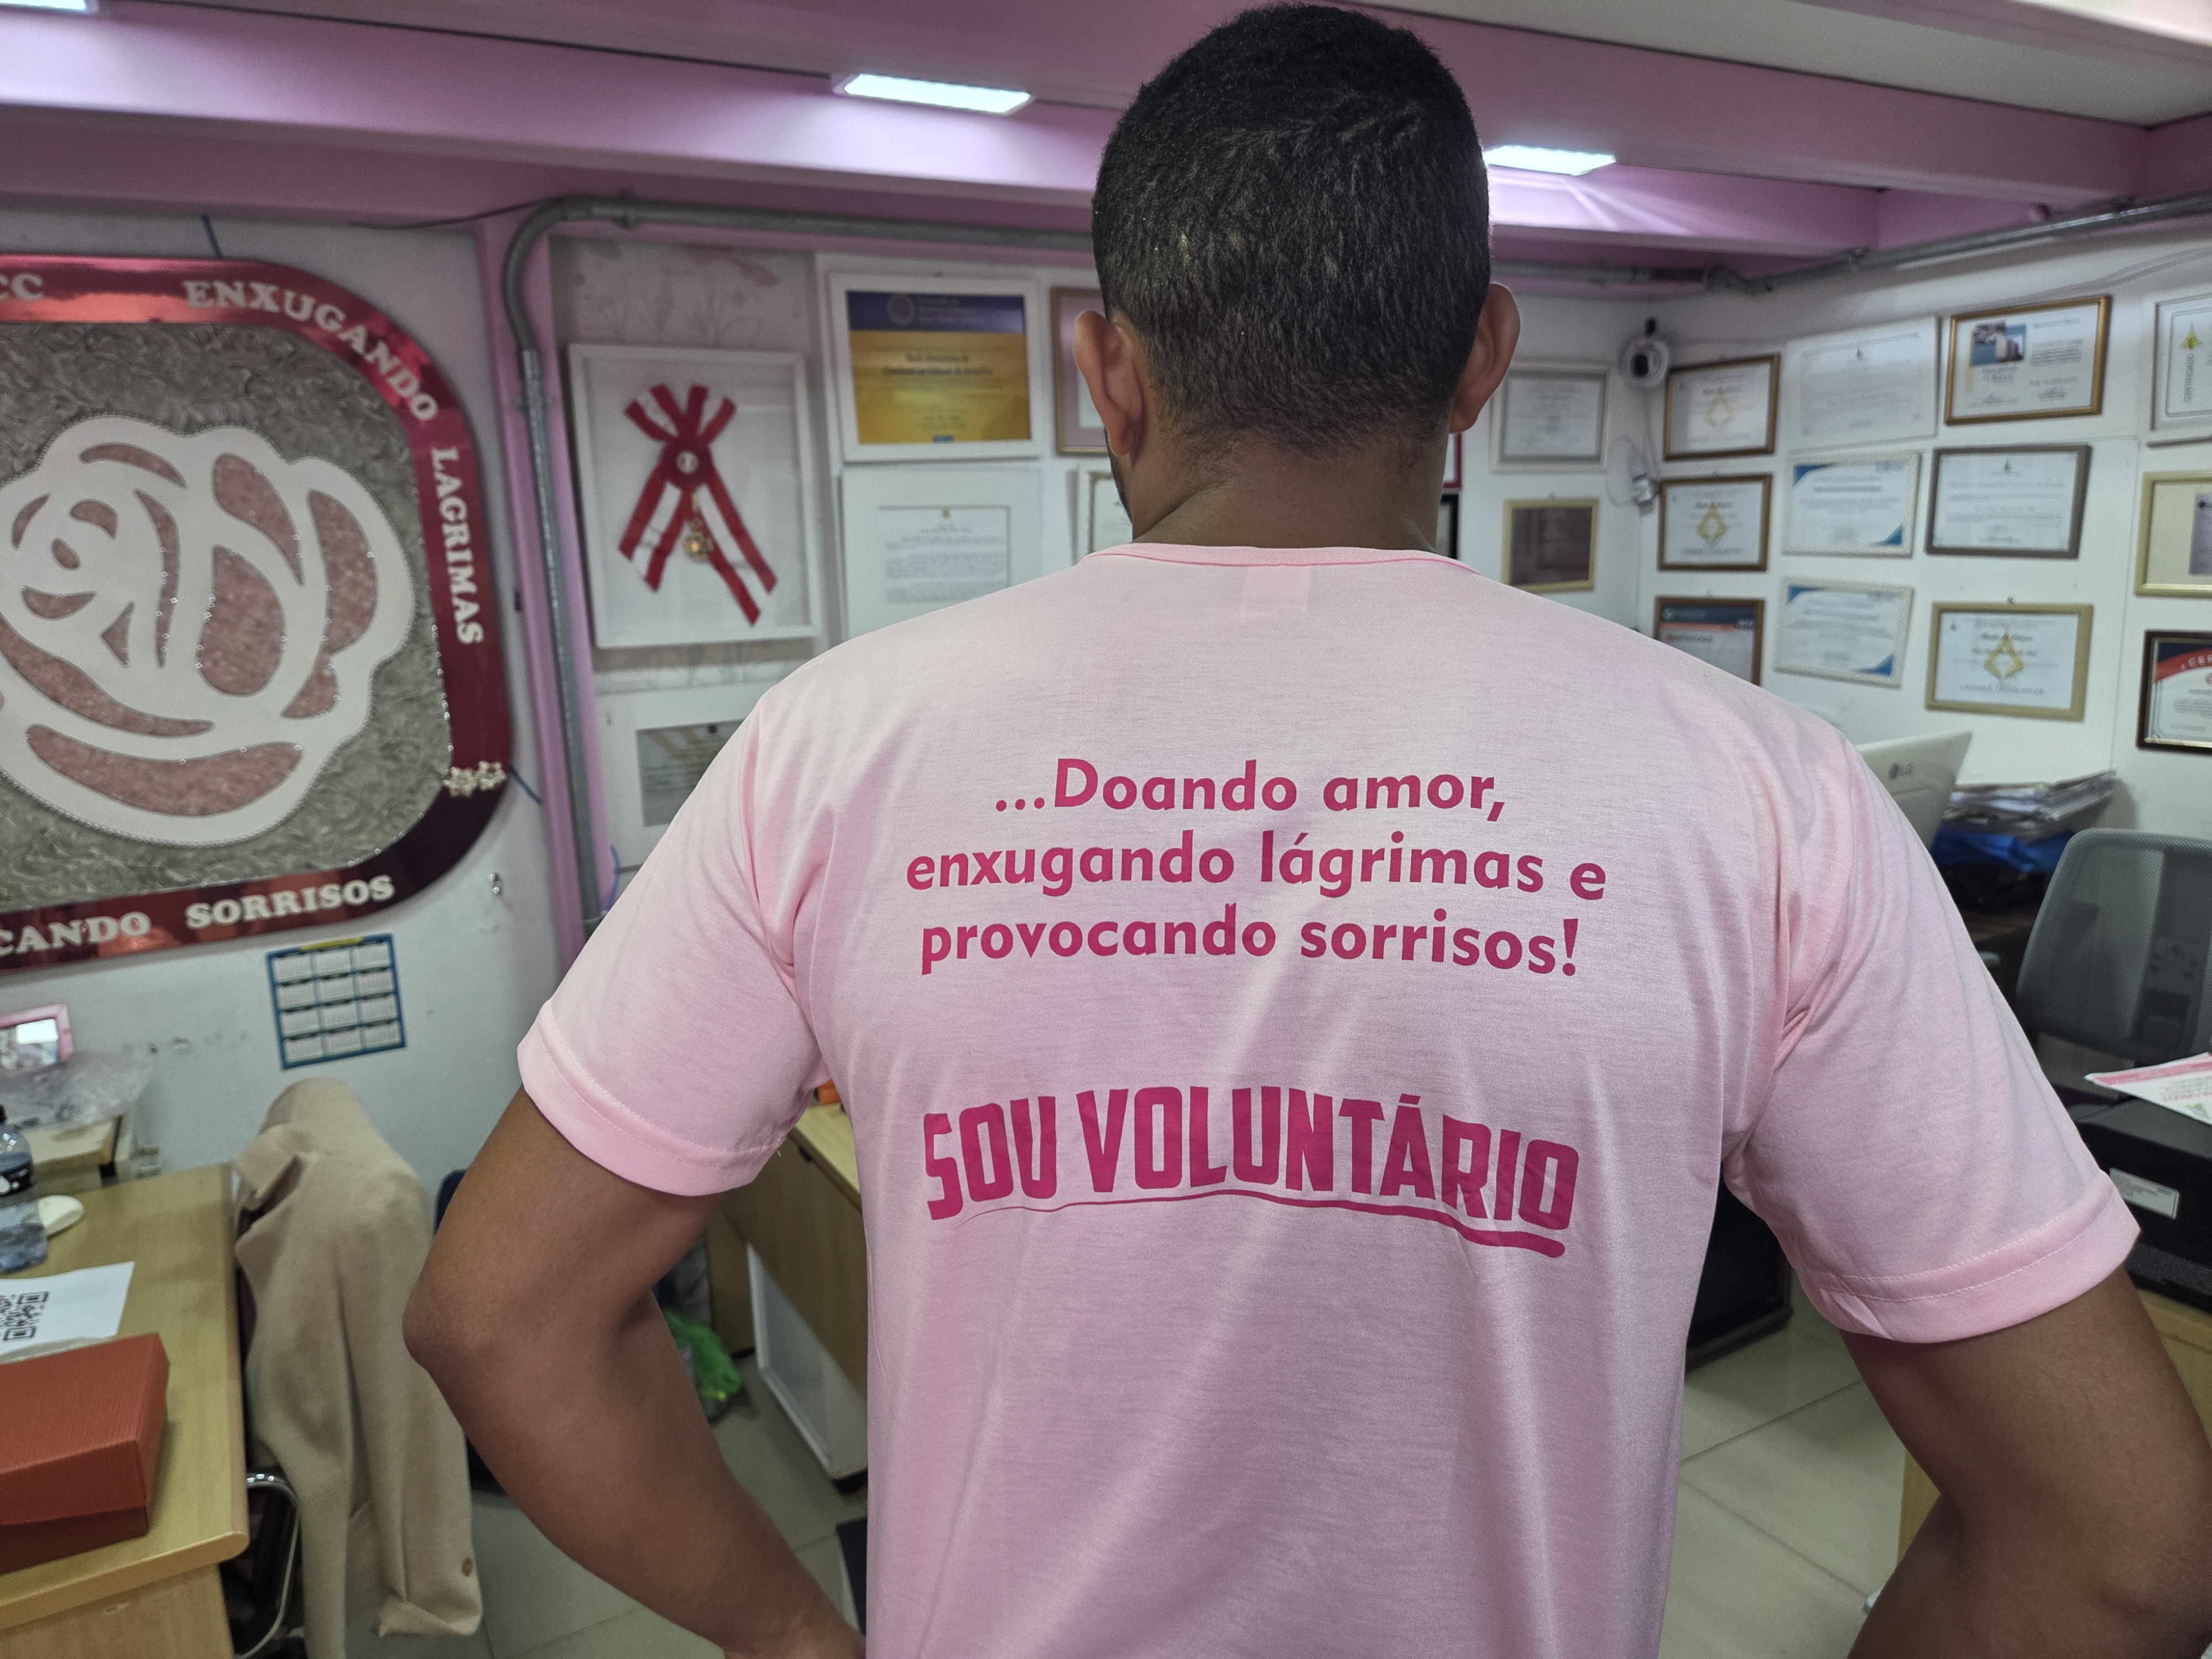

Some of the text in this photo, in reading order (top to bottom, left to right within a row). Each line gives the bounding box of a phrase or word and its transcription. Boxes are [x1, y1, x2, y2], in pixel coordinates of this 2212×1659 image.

[182, 280, 485, 645] ENXUGANDO LAGRIMAS
[995, 758, 1505, 822] ...Doando amor,
[906, 830, 1606, 900] enxugando lágrimas e
[185, 875, 395, 929] SORRISOS
[921, 903, 1579, 977] provocando sorrisos!
[923, 1086, 1580, 1230] SOU VOLUNTÁRIO
